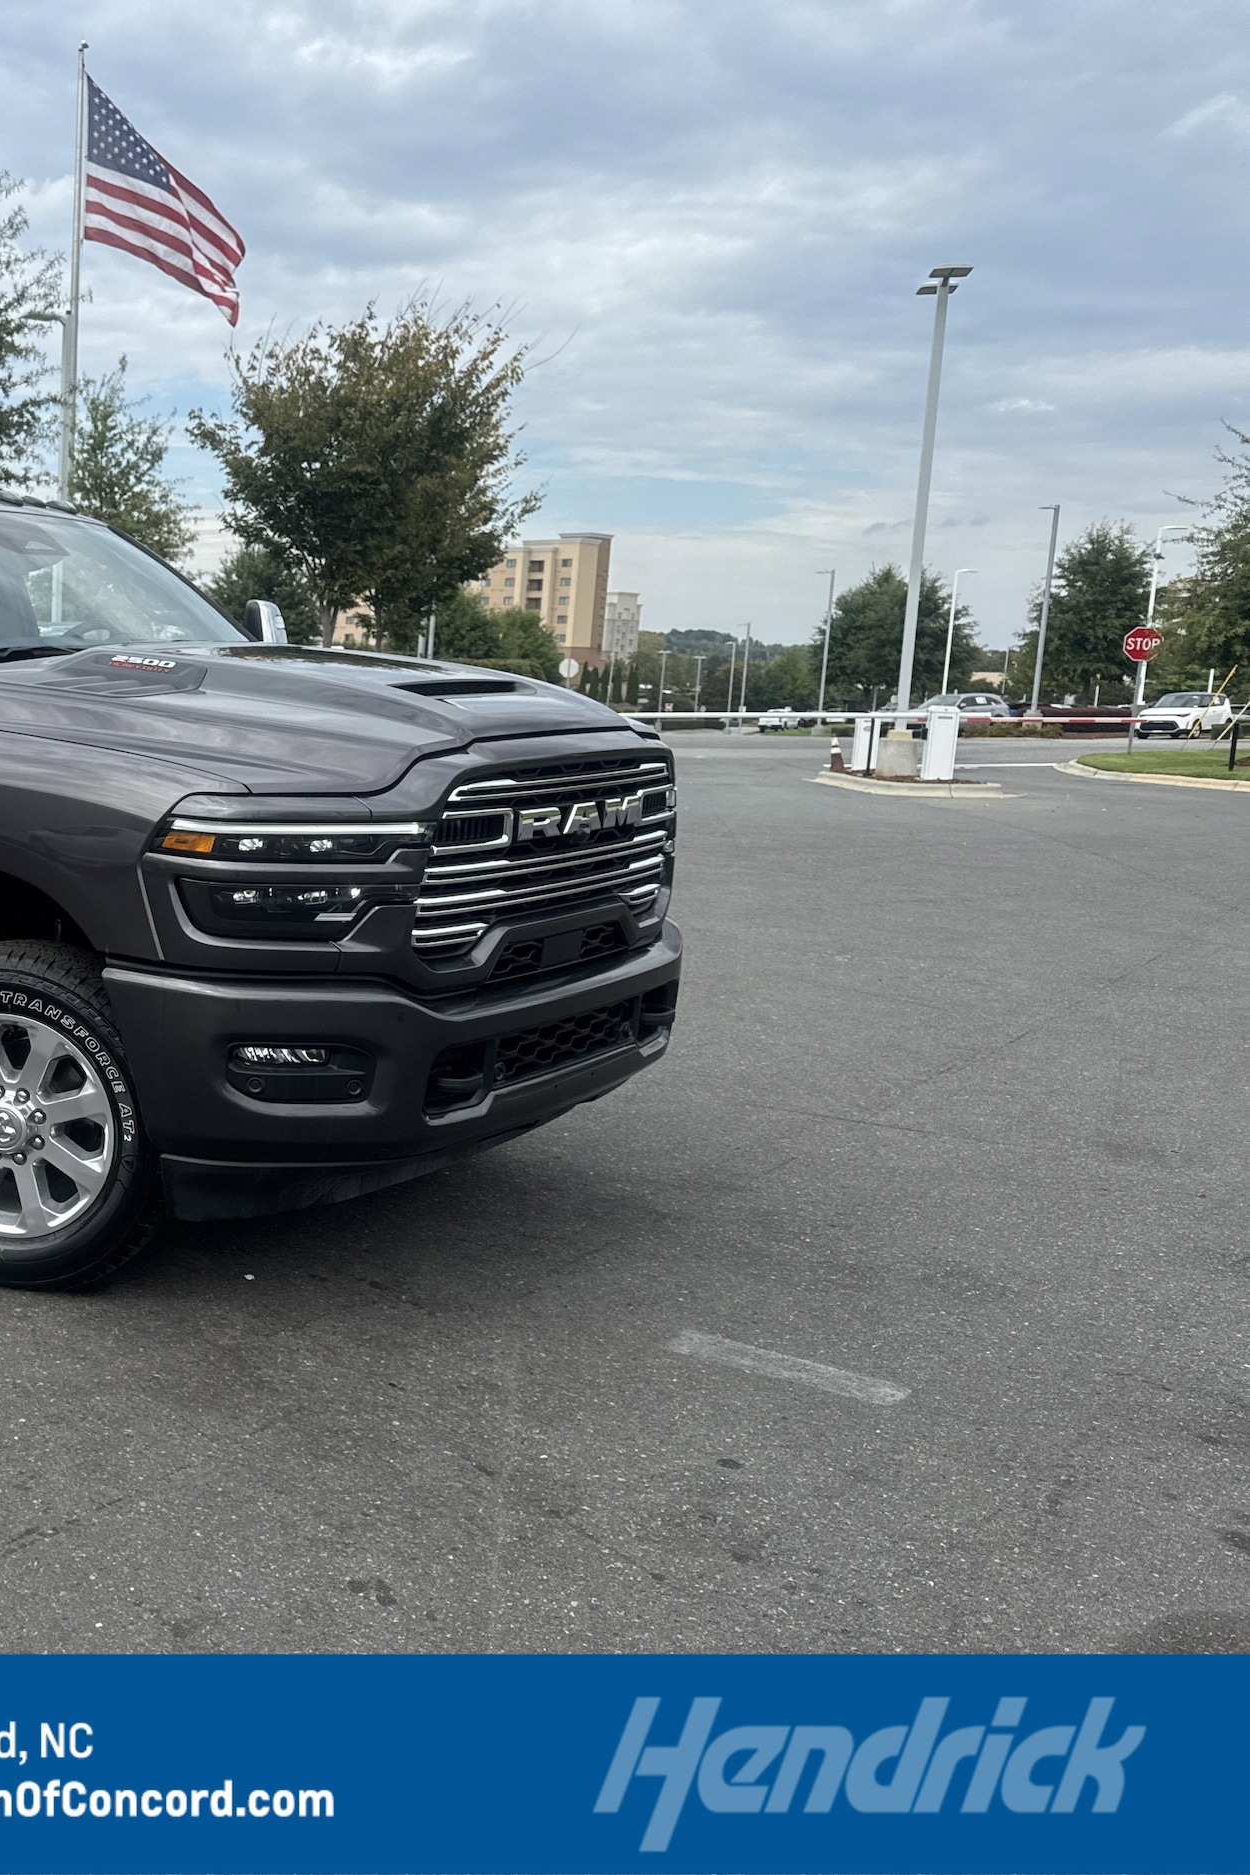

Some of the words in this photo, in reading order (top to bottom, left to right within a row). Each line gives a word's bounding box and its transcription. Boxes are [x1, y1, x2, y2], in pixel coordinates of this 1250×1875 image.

[1126, 637, 1161, 651] STOP
[108, 661, 141, 670] HEAVY
[142, 665, 172, 673] DUTY
[111, 654, 177, 669] 2500
[517, 796, 643, 841] RAM
[0, 990, 127, 1095] TRANSFORCE
